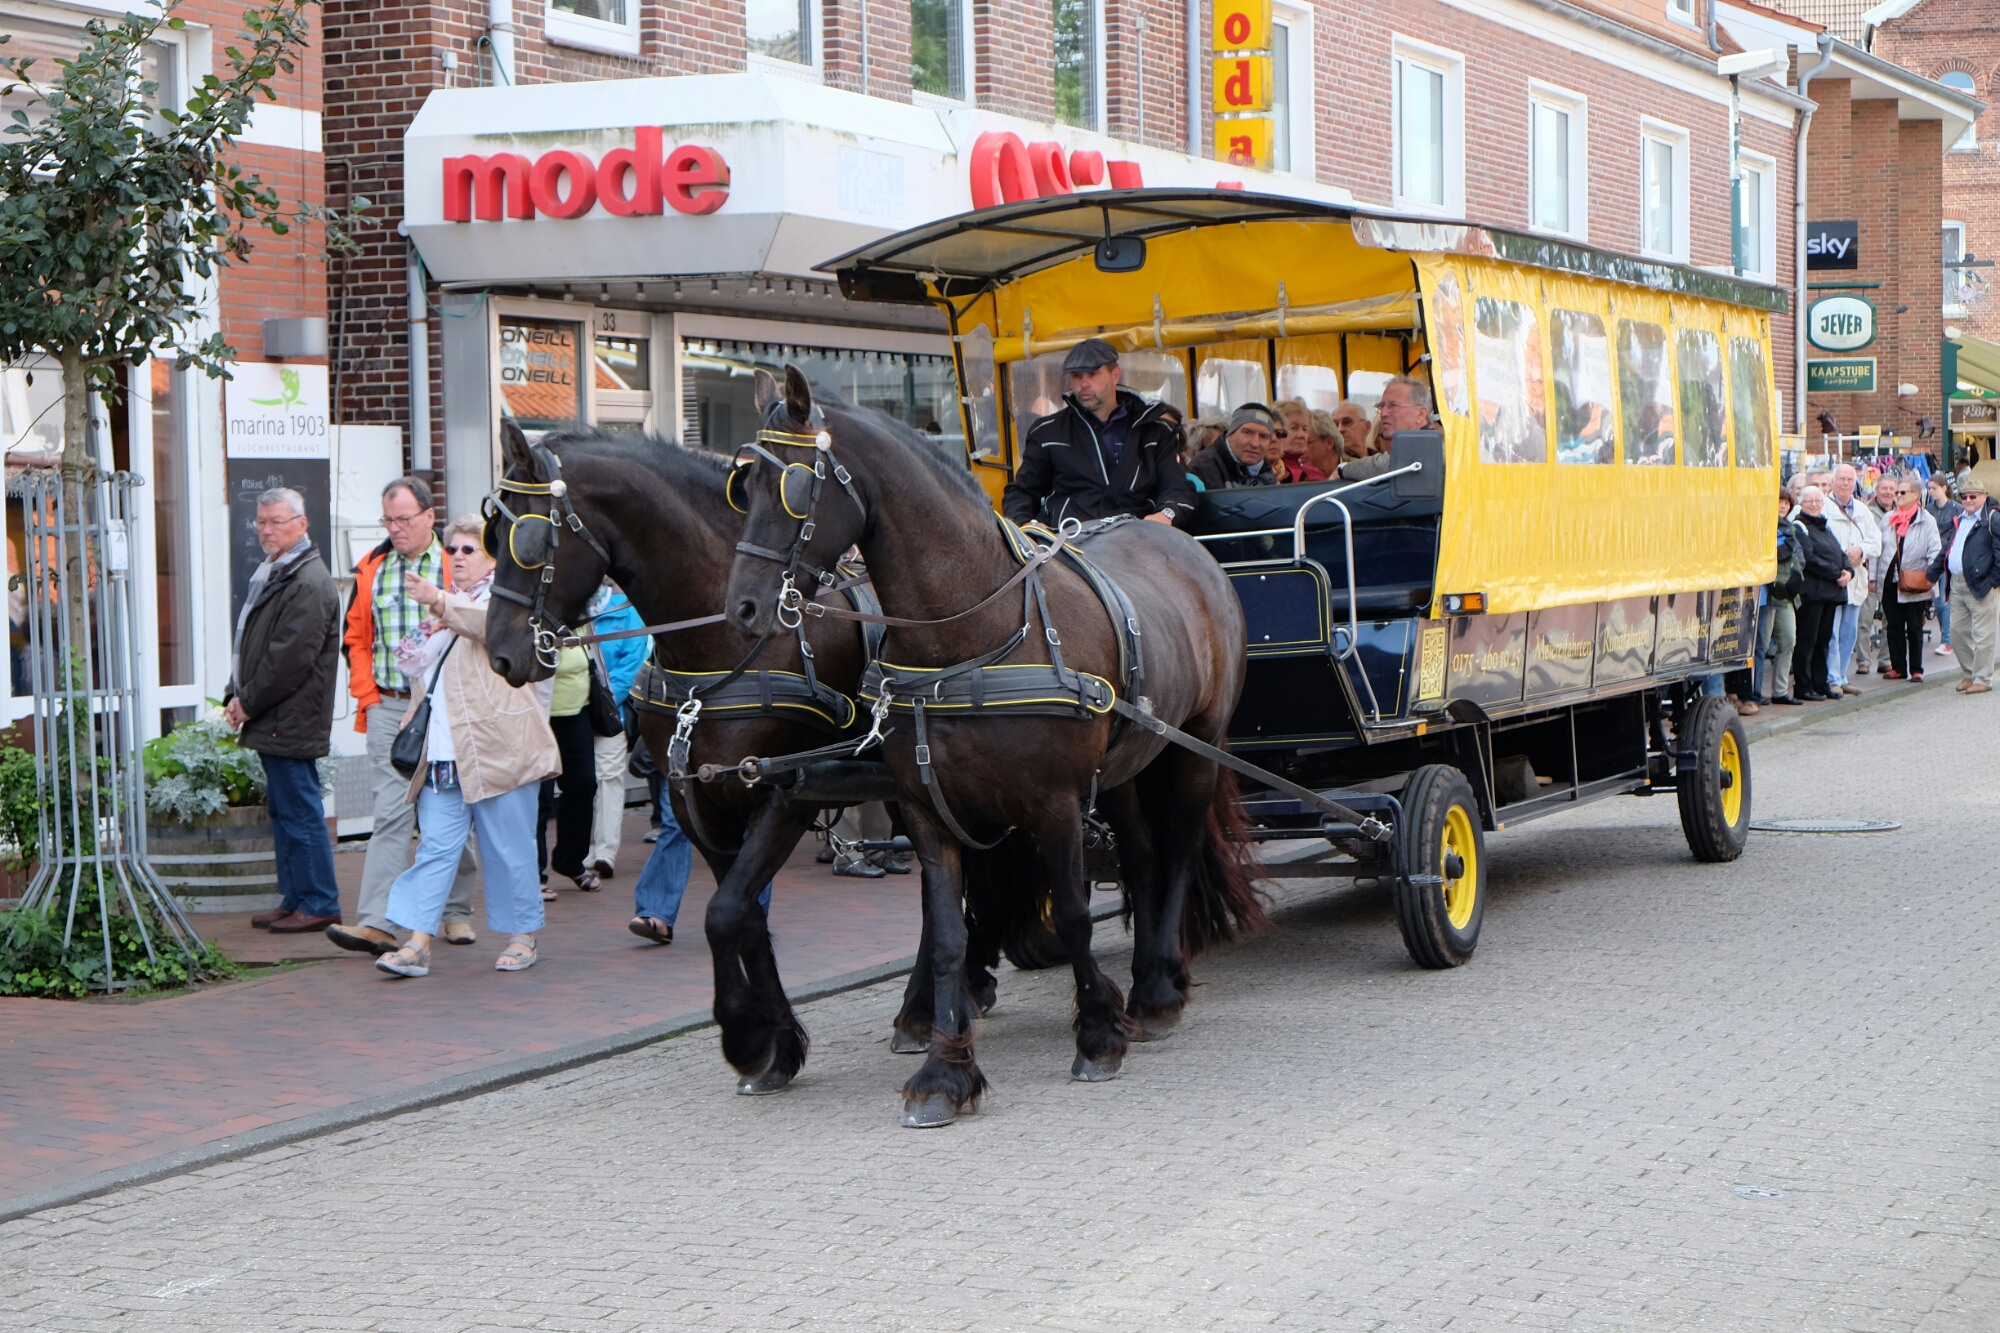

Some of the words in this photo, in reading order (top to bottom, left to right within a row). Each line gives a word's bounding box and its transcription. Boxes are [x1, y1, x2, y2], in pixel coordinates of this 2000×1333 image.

[442, 126, 731, 223] mode
[1806, 232, 1851, 259] sky
[603, 312, 616, 331] 33
[1820, 313, 1863, 336] JEVER
[501, 366, 571, 386] O'NEILL
[1811, 365, 1871, 377] KAAPSTUBE
[231, 414, 285, 435] marina
[290, 415, 325, 436] 1903
[237, 443, 320, 453] FISCHRESTAURANT
[1453, 653, 1475, 678] 0175
[1481, 643, 1498, 676] 460
[1499, 650, 1510, 669] 10
[1509, 648, 1522, 675] 45
